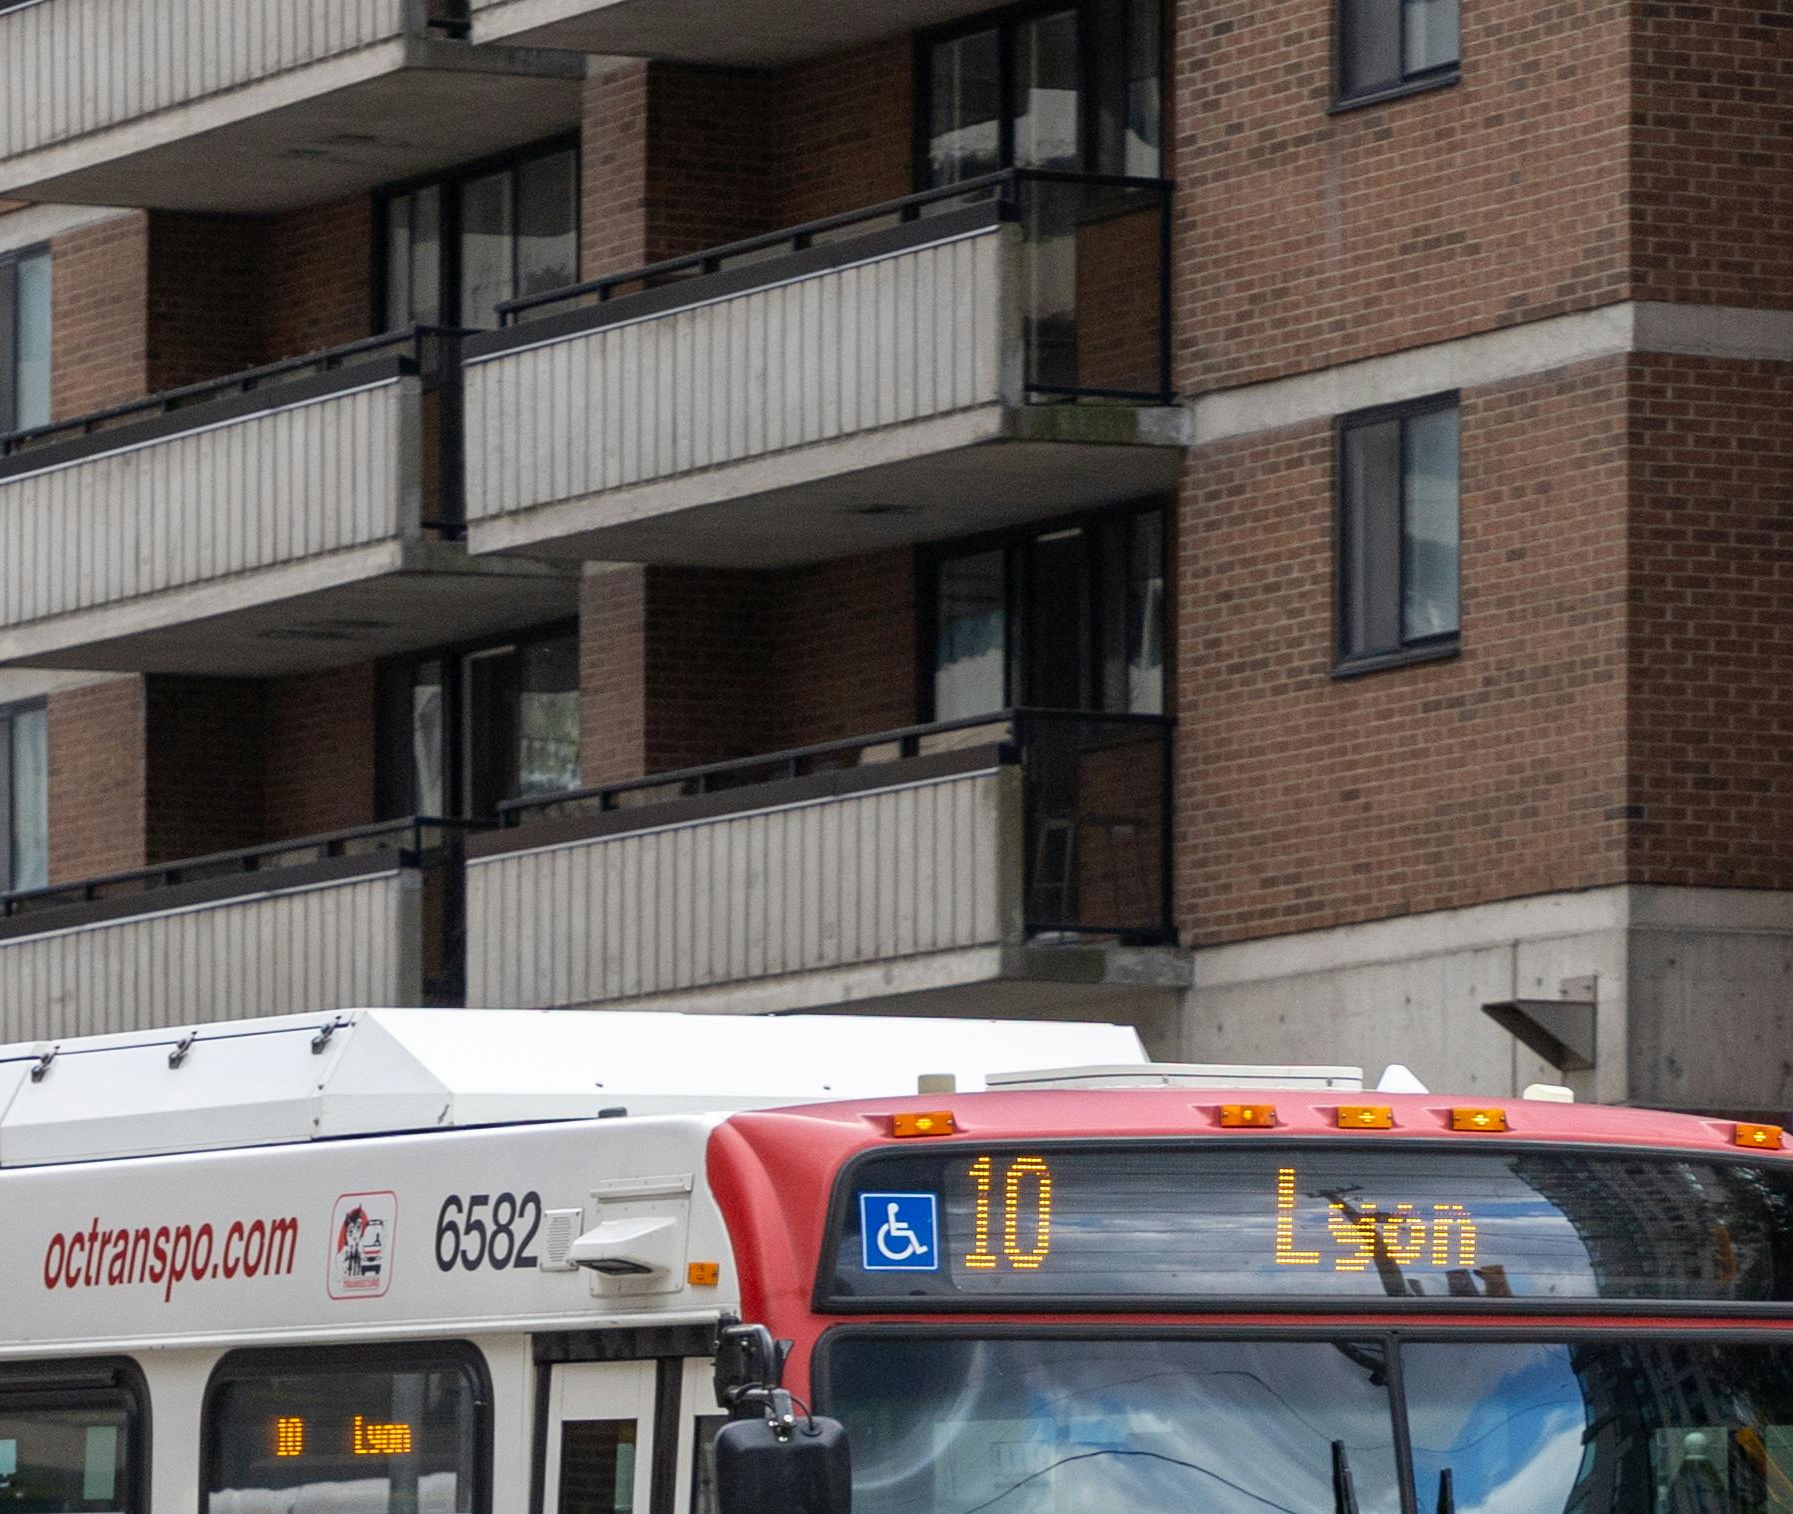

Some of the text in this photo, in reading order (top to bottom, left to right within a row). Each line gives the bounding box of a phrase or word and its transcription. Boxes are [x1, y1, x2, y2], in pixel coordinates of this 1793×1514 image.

[435, 1190, 542, 1273] 6582
[965, 1156, 1476, 1271] 10 Lyon
[43, 1216, 298, 1303] octranspo.com
